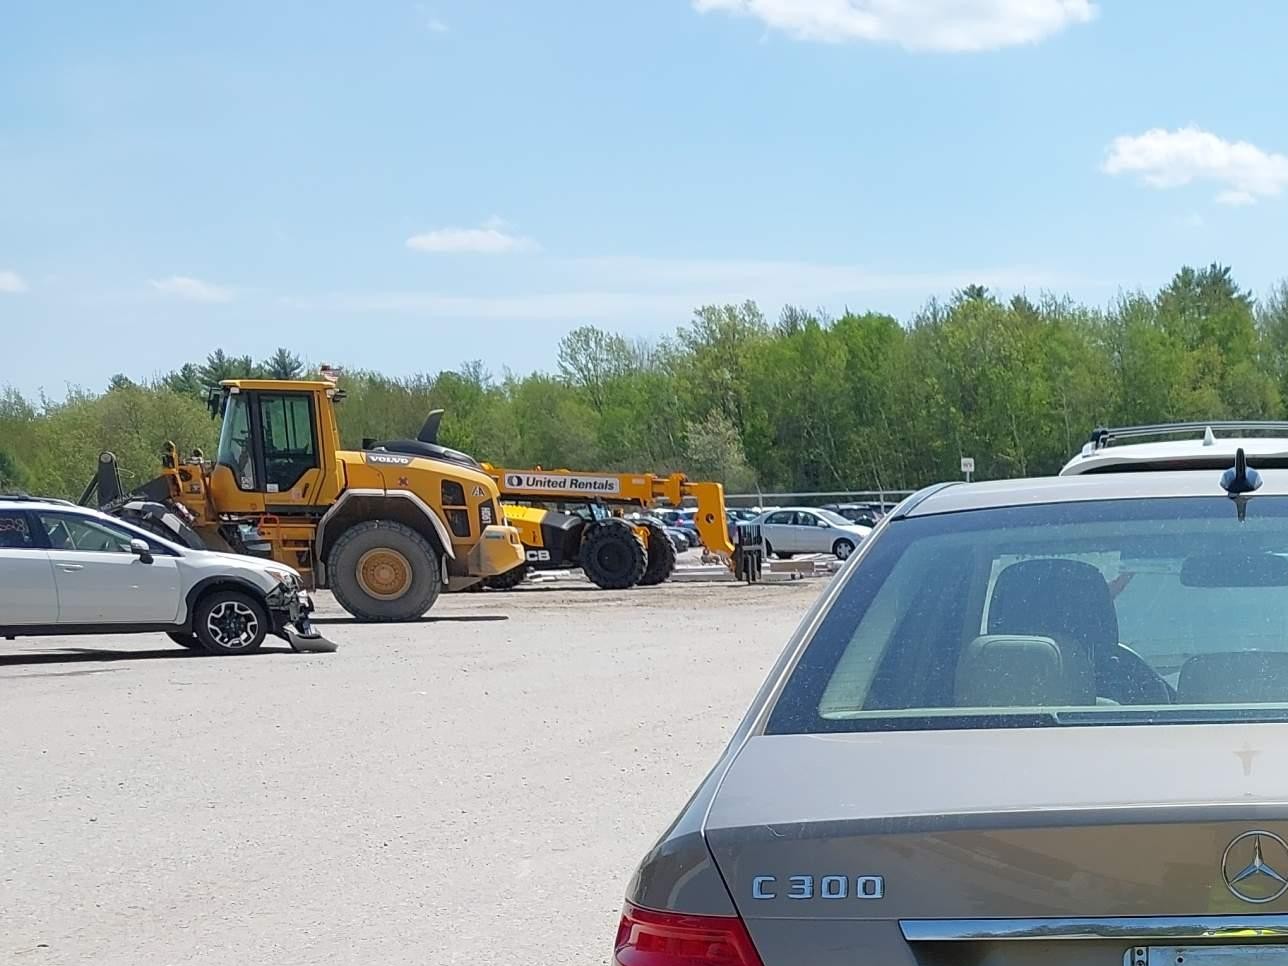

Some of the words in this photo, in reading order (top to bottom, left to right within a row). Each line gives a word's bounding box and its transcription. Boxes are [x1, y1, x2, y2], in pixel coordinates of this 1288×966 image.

[369, 455, 409, 465] VOLVO
[526, 477, 566, 489] United
[569, 478, 614, 491] Rentals
[526, 550, 550, 561] CB
[752, 875, 777, 900] C
[787, 874, 885, 900] 300
